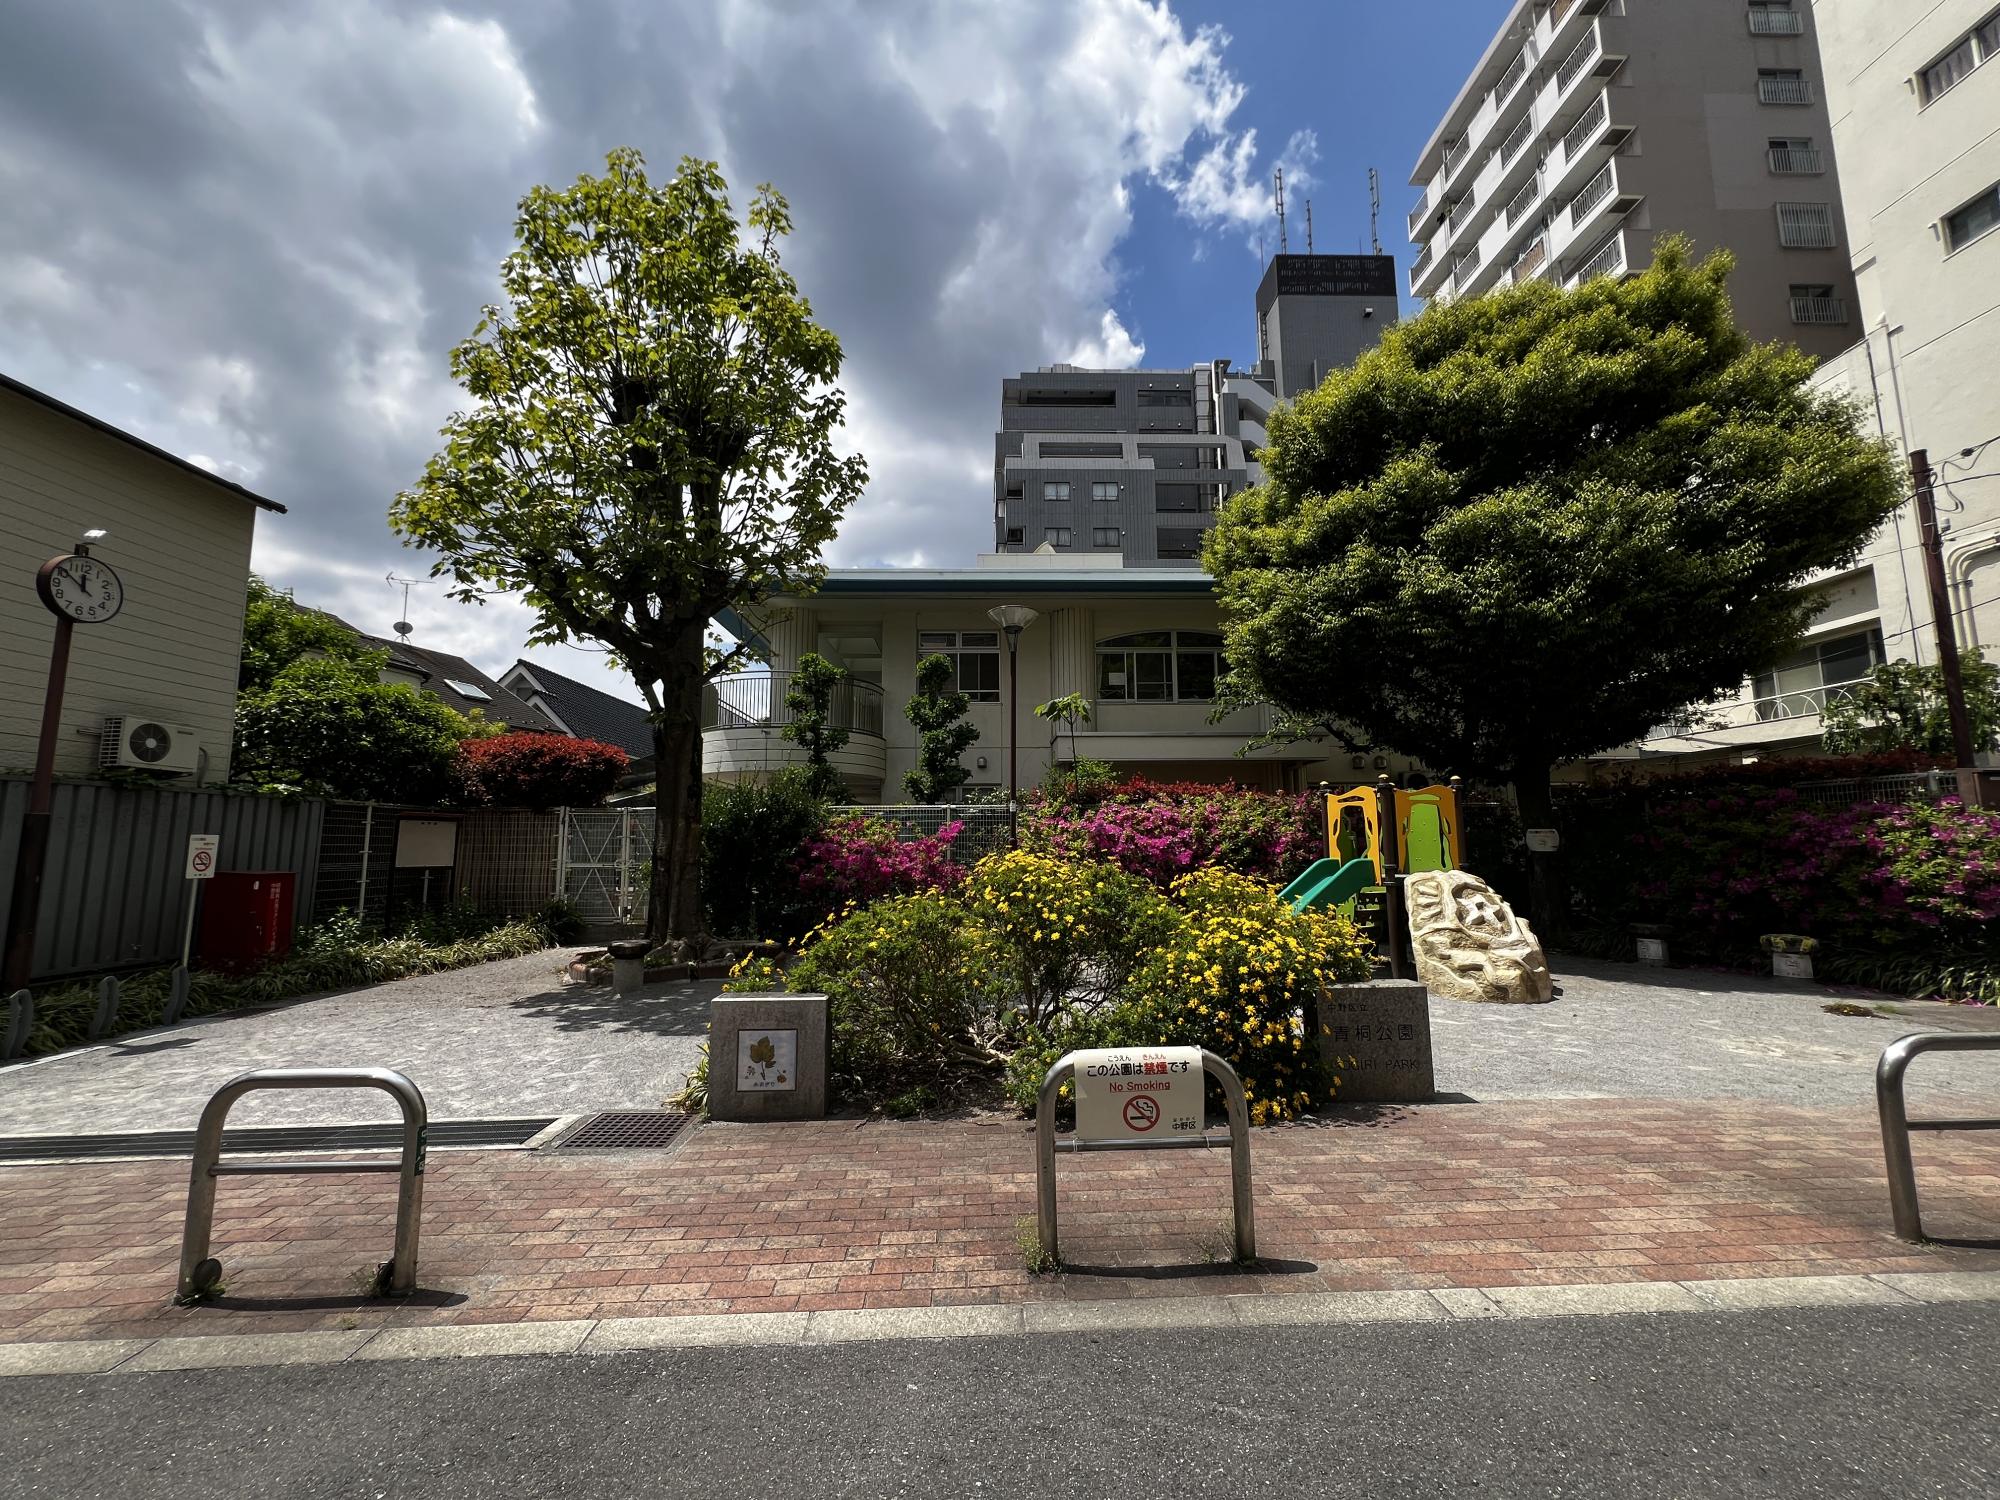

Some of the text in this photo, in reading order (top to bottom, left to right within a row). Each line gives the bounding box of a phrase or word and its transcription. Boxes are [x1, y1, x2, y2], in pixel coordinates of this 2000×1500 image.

[81, 563, 92, 575] 12
[52, 577, 61, 587] 9
[102, 580, 110, 590] 2
[55, 589, 64, 599] 8
[103, 591, 111, 601] 3
[65, 600, 73, 609] 7
[98, 601, 106, 609] 4
[75, 605, 83, 615] 6
[88, 606, 96, 616] 5
[1334, 1023, 1414, 1041] 青桐公園
[1142, 1053, 1167, 1061] きんえん
[1087, 1060, 1190, 1077] この公園は禁煙です
[1386, 1060, 1418, 1070] PARK
[1109, 1080, 1171, 1092] No Smoking
[1172, 1121, 1197, 1130] 中野区
